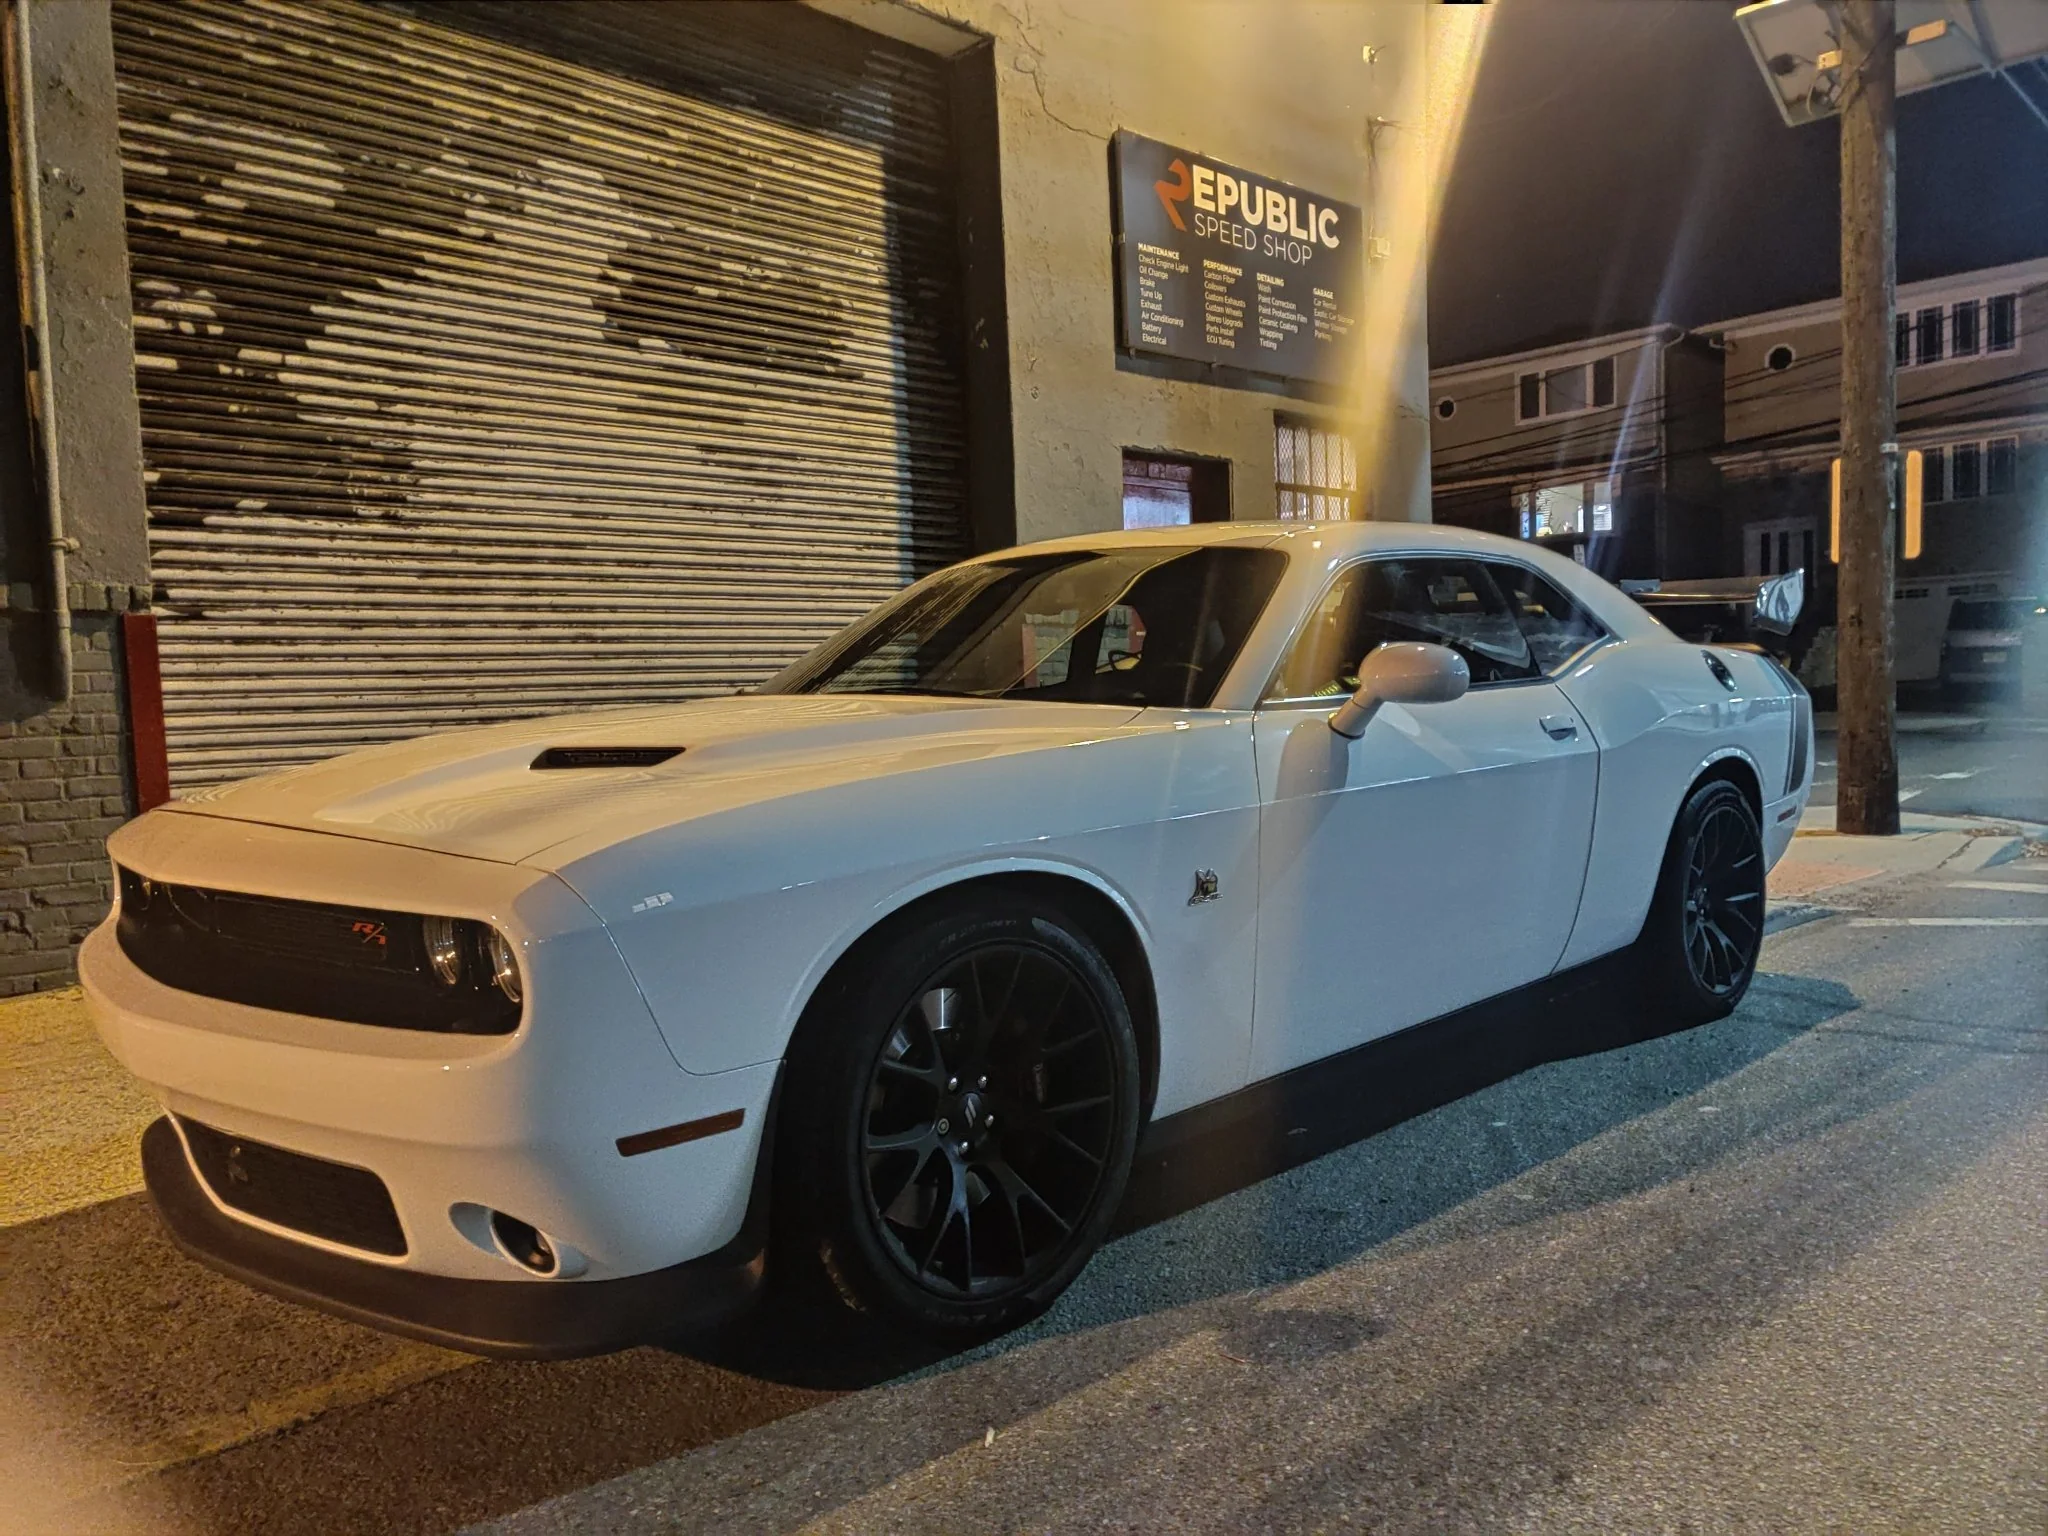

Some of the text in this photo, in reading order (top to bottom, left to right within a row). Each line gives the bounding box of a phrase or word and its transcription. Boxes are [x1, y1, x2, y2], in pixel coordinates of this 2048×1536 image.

[1153, 158, 1340, 248] REPUBLIC
[1195, 213, 1312, 266] SPEED SHOP
[1138, 242, 1180, 260] MAINTENANCE
[1138, 254, 1189, 273] Check Engine Light
[1203, 259, 1242, 276] PERFORMANCE
[1139, 265, 1169, 280] Oil Change
[1256, 272, 1284, 287] DETAILING
[1140, 287, 1163, 301] Tune Up
[1140, 299, 1162, 311] Exhaust
[1271, 297, 1296, 310] Correction
[1141, 311, 1184, 328] Air Conditioning
[1271, 308, 1296, 321] Protection
[1142, 321, 1162, 334] Battery
[1259, 327, 1283, 341] Wrapping
[1142, 333, 1167, 345] Electrical
[1206, 334, 1235, 349] ECU Tuning
